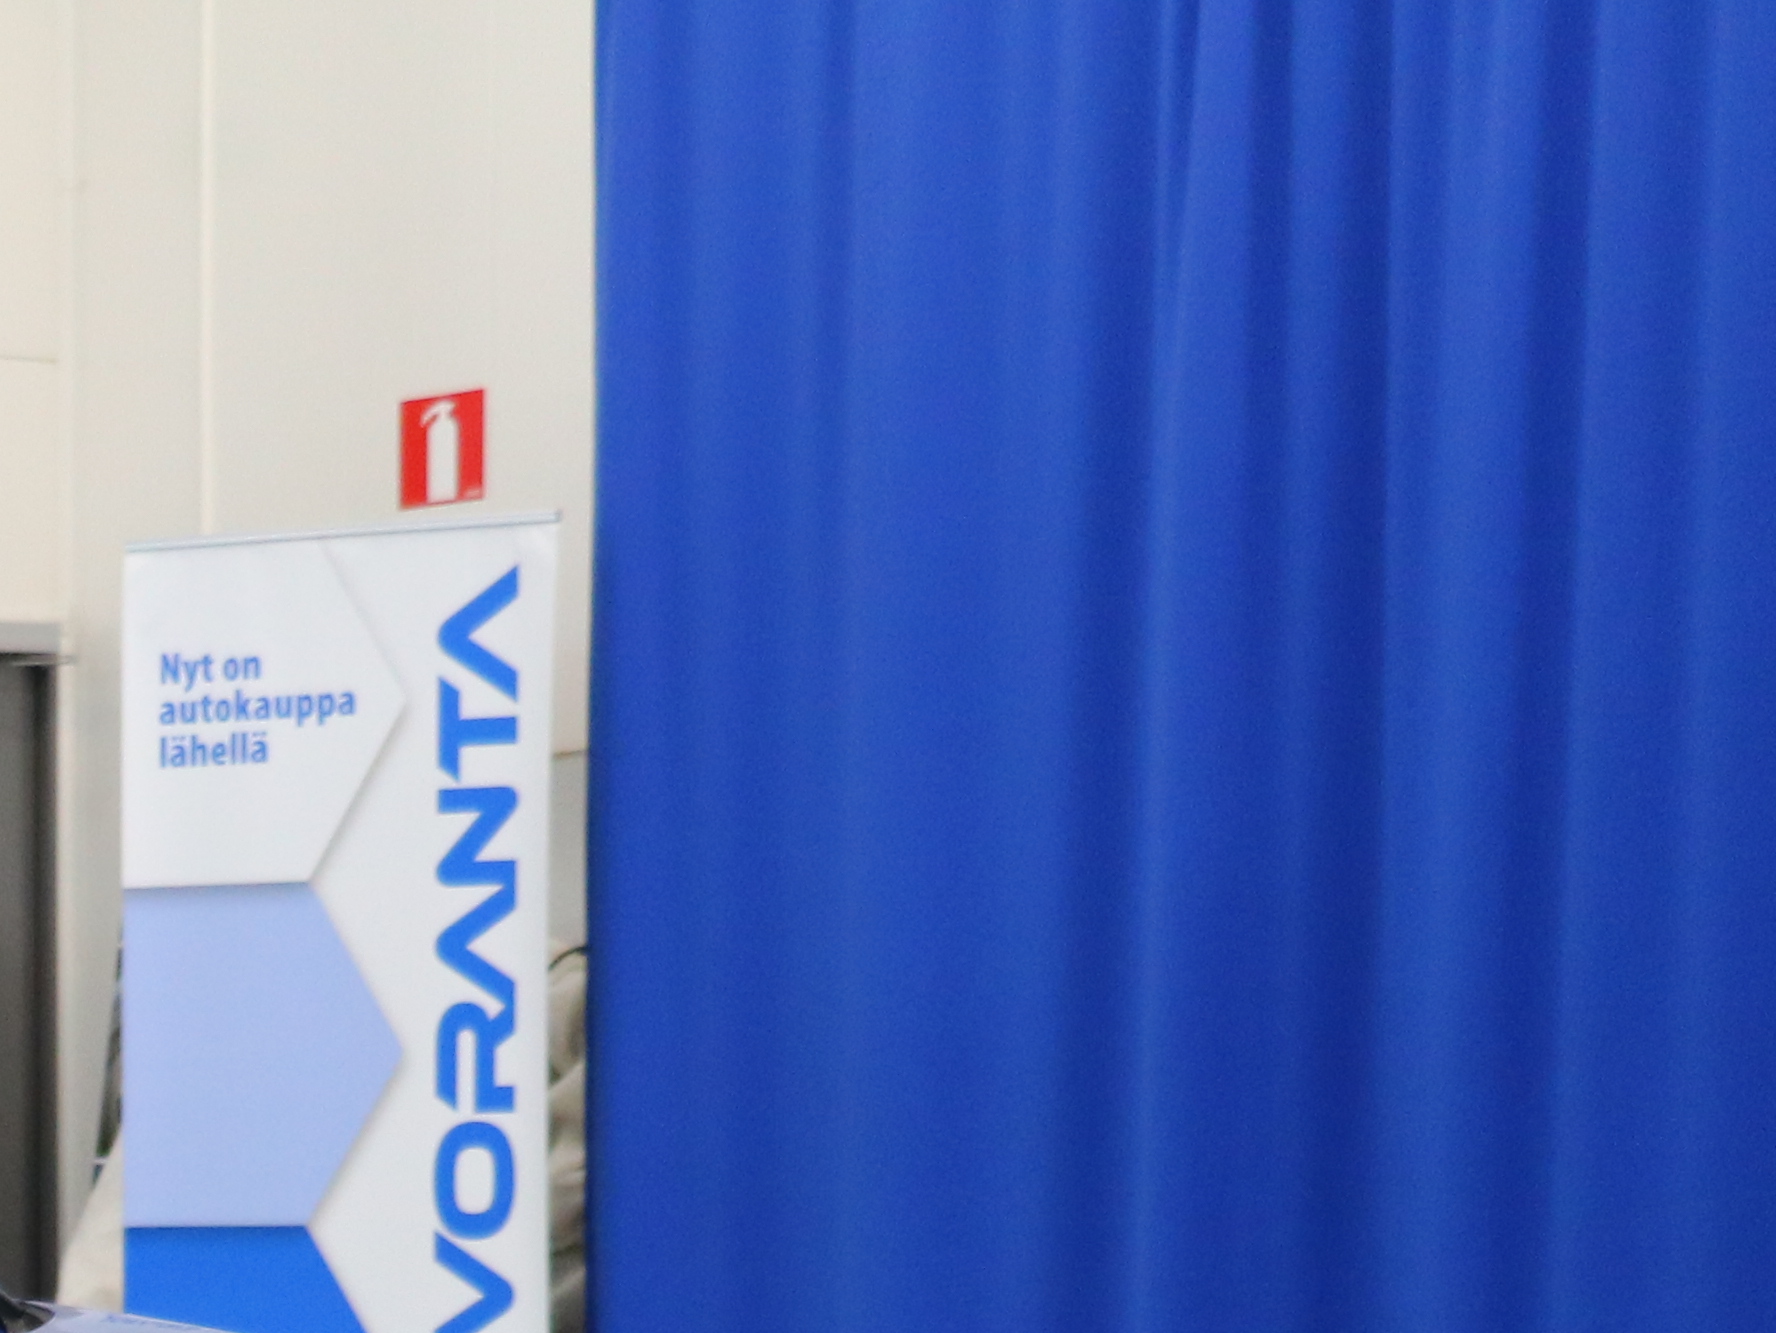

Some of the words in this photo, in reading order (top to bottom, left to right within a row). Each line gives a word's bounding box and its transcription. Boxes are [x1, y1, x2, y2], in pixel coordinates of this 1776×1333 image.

[160, 652, 213, 692] Nyt
[223, 655, 262, 681] on
[159, 689, 356, 727] autokauppa
[159, 731, 268, 768] lähellä
